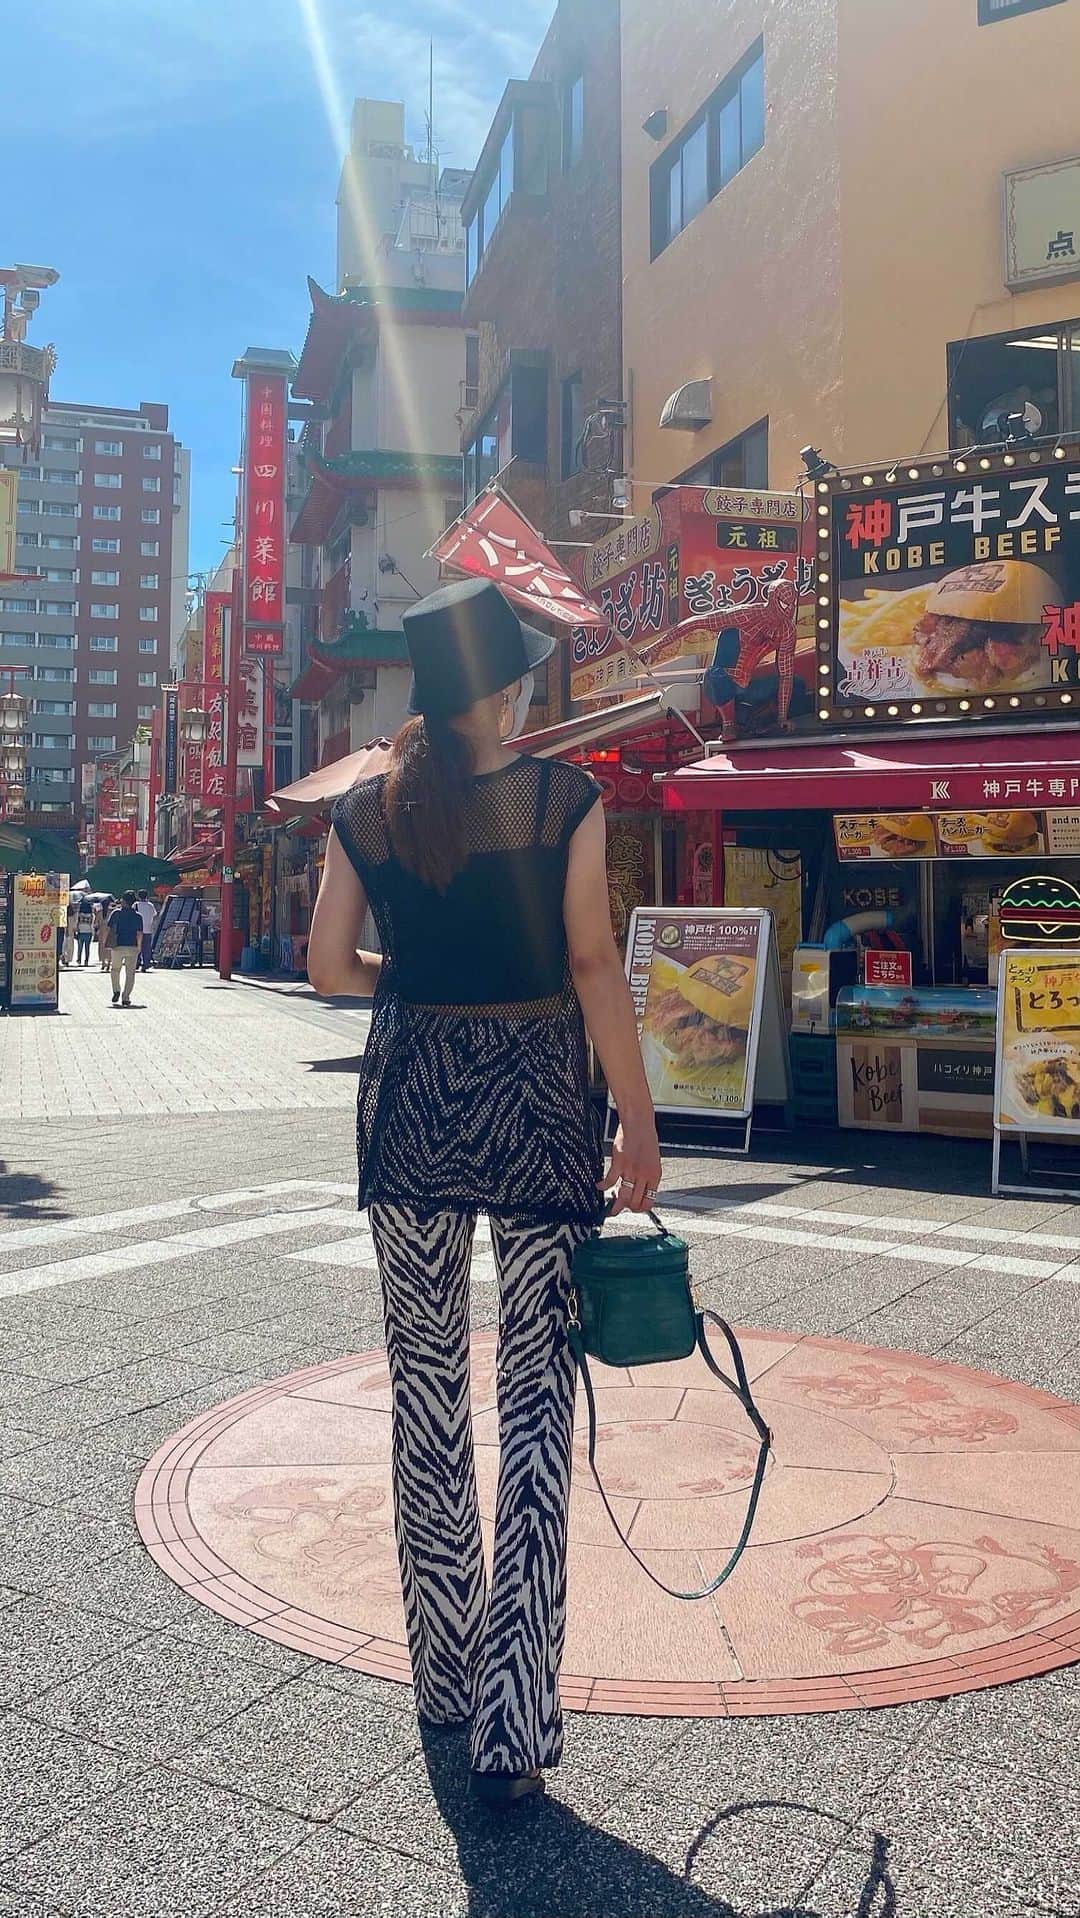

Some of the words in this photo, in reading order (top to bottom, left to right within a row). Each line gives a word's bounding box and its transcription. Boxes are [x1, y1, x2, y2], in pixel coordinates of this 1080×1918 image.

[1046, 231, 1076, 260] 点
[716, 496, 797, 517] 餃子専門店
[249, 464, 280, 605] 四川菜館
[727, 526, 779, 549] 元祖
[592, 517, 652, 582] 餃子専門店
[863, 541, 945, 574] KOBE
[974, 527, 1061, 560] BEEF
[669, 547, 679, 599] 元祖
[1052, 658, 1080, 683] K
[840, 819, 878, 830] ステーキ
[940, 817, 967, 827] チーズ
[1052, 816, 1069, 824] and
[843, 888, 899, 907] KOBE
[684, 924, 715, 936] 神戸牛
[719, 925, 758, 936] 100%!!
[632, 920, 657, 968] KOBE
[1010, 976, 1033, 984] チーズ
[850, 1056, 900, 1092] Kobe
[868, 1083, 904, 1112] Beef
